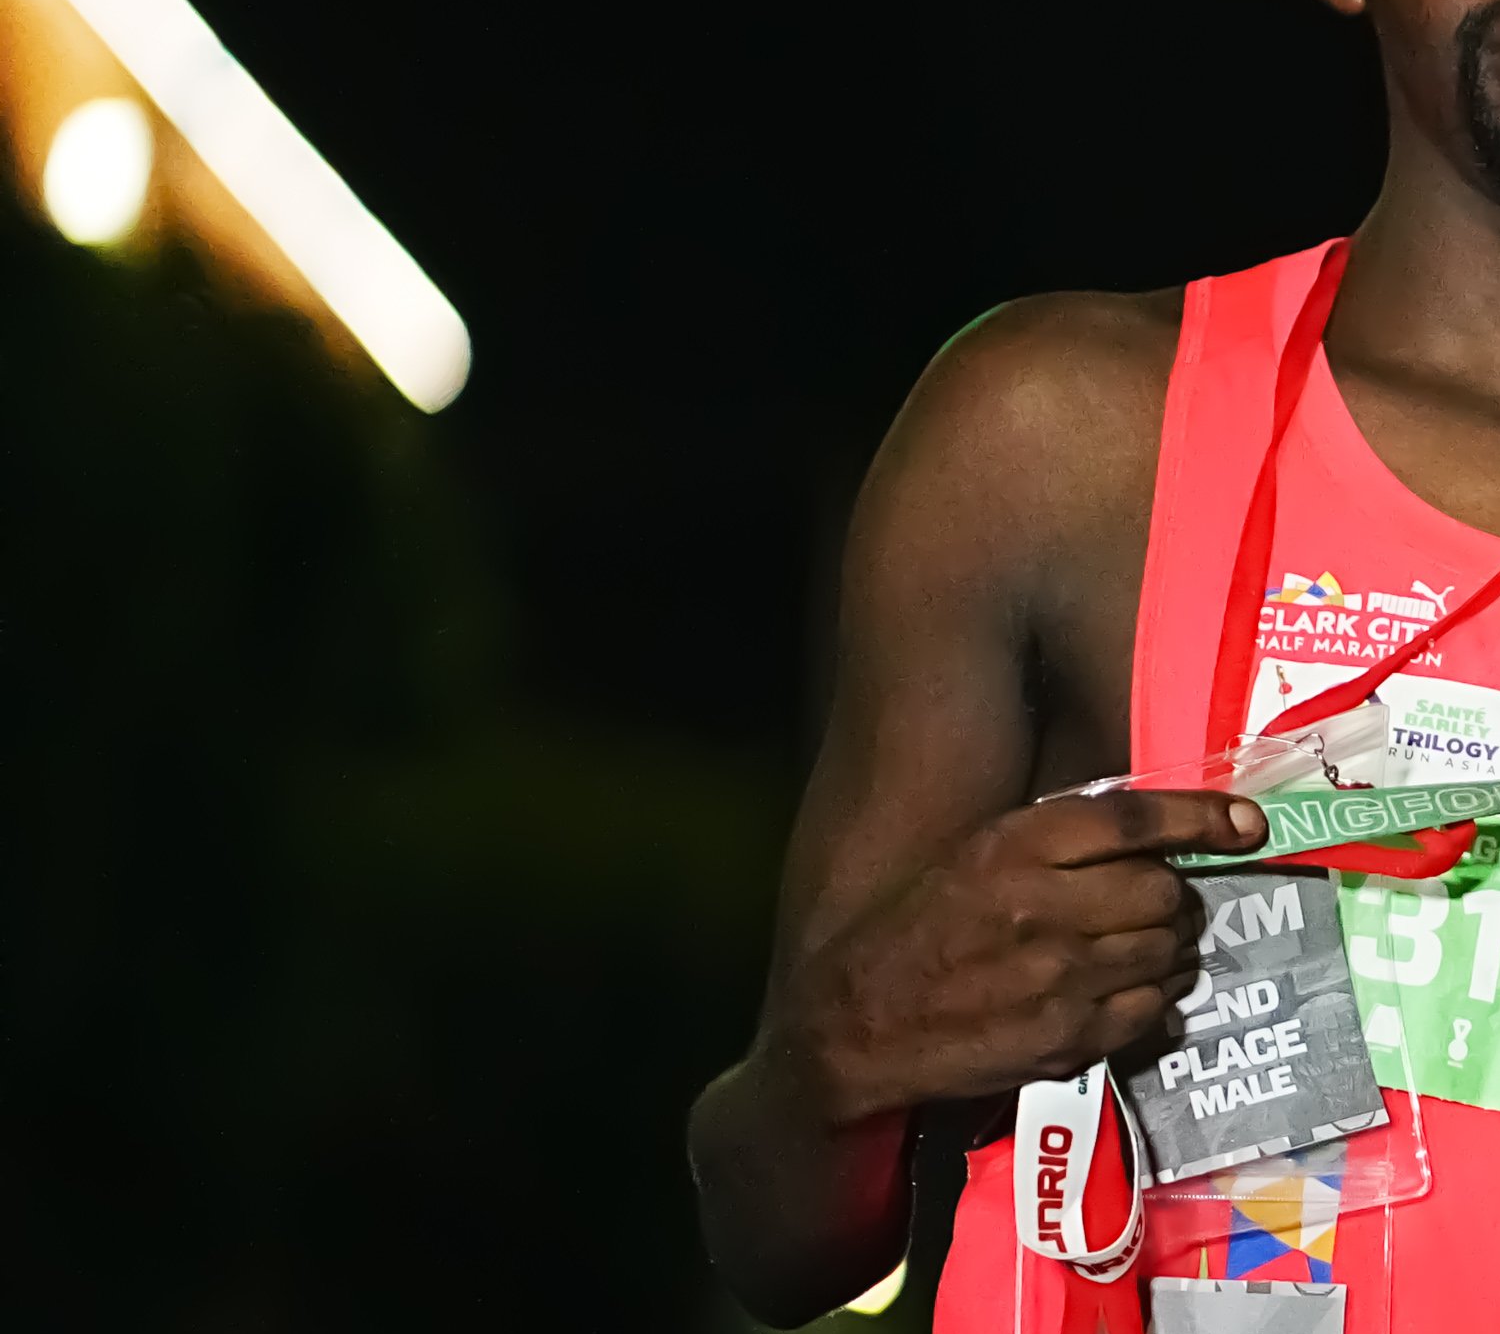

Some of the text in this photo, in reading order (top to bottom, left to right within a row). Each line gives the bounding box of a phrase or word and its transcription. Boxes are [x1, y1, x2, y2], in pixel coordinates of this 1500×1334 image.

[1258, 607, 1430, 644] CLARK CIT
[1255, 634, 1304, 652] HALF
[1404, 712, 1491, 740] BARLEY
[1415, 698, 1487, 724] SANTÉ
[1393, 727, 1500, 761] TRILOGY
[1388, 748, 1497, 776] RUN ASIA
[1158, 1018, 1307, 1091] PLACE
[1189, 1065, 1298, 1121] MALE
